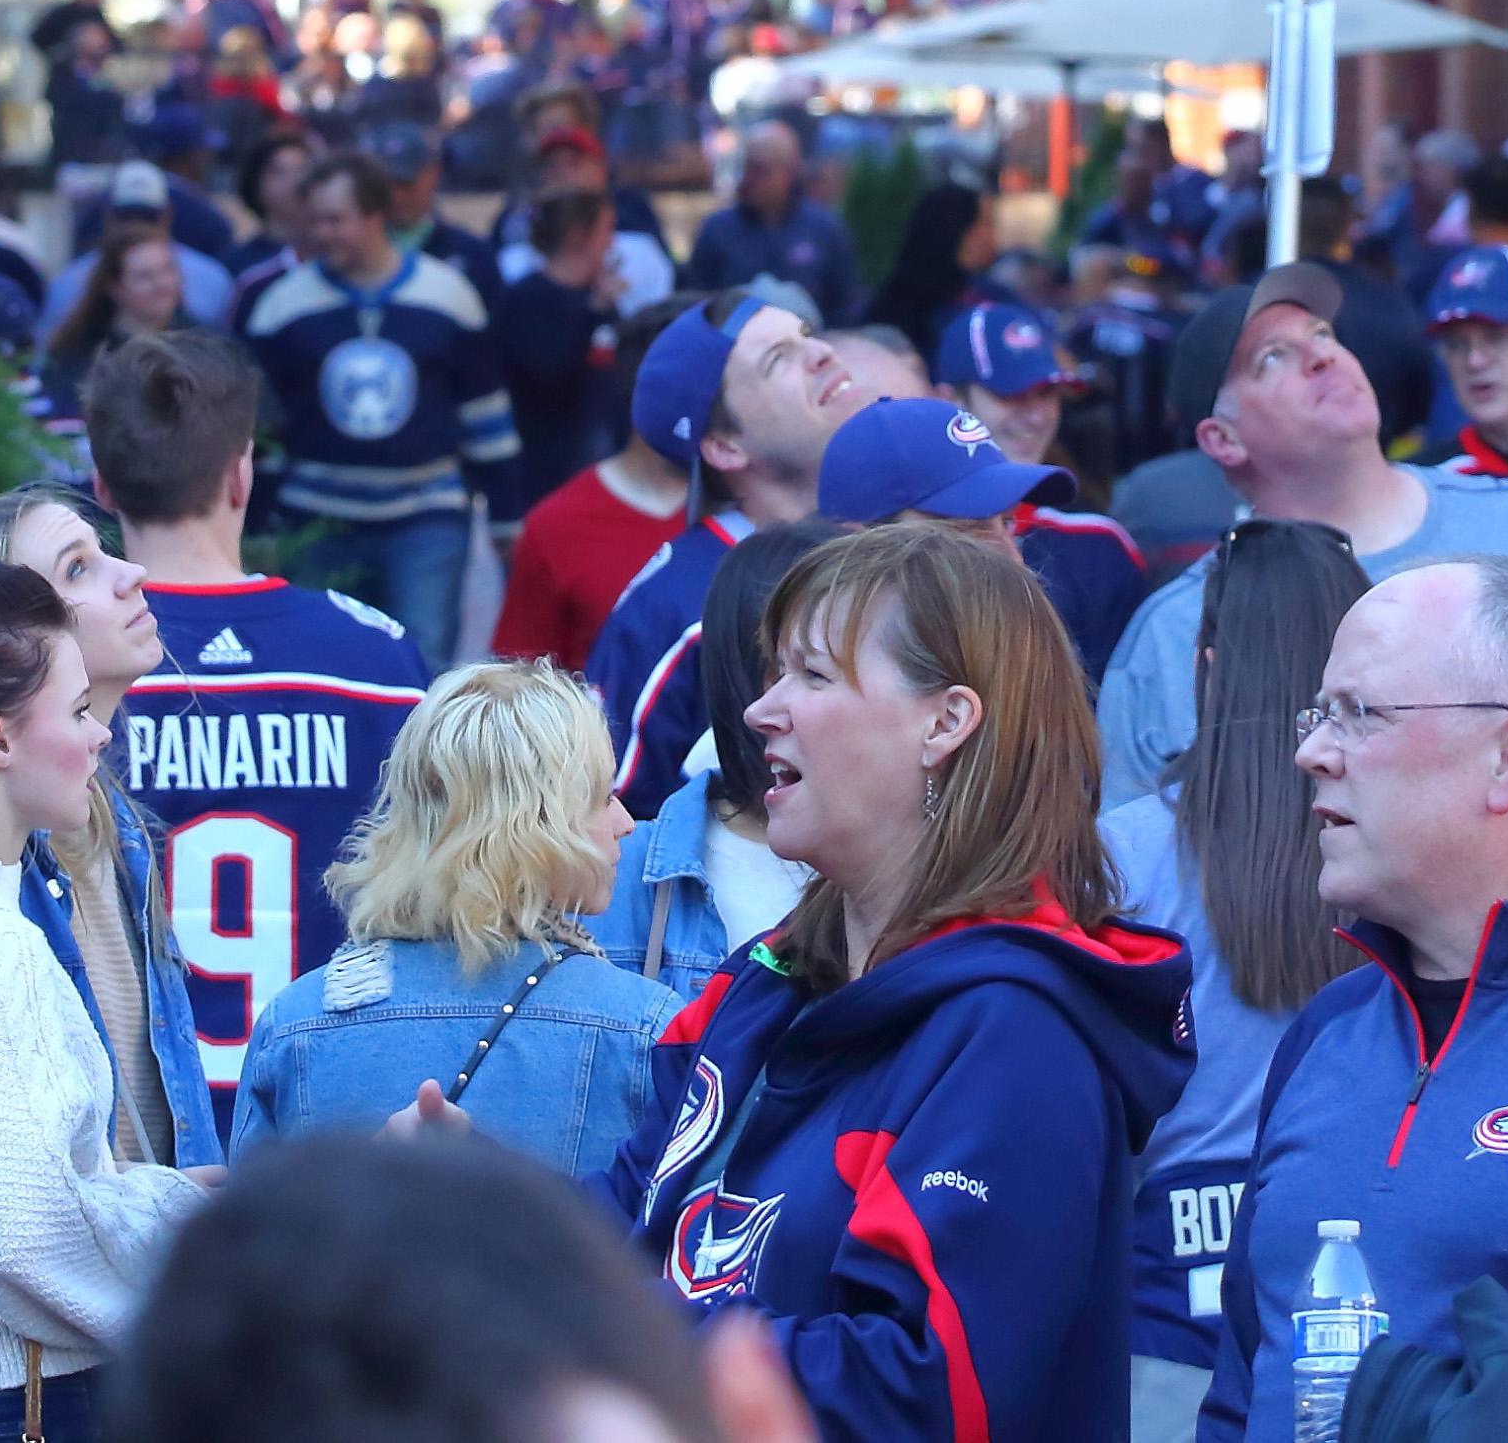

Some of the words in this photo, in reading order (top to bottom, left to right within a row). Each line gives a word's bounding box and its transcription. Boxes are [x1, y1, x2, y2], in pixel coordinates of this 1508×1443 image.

[198, 650, 253, 665] adidas
[128, 713, 348, 791] PANARIN
[165, 810, 299, 1090] 9
[921, 1170, 989, 1203] Reebok
